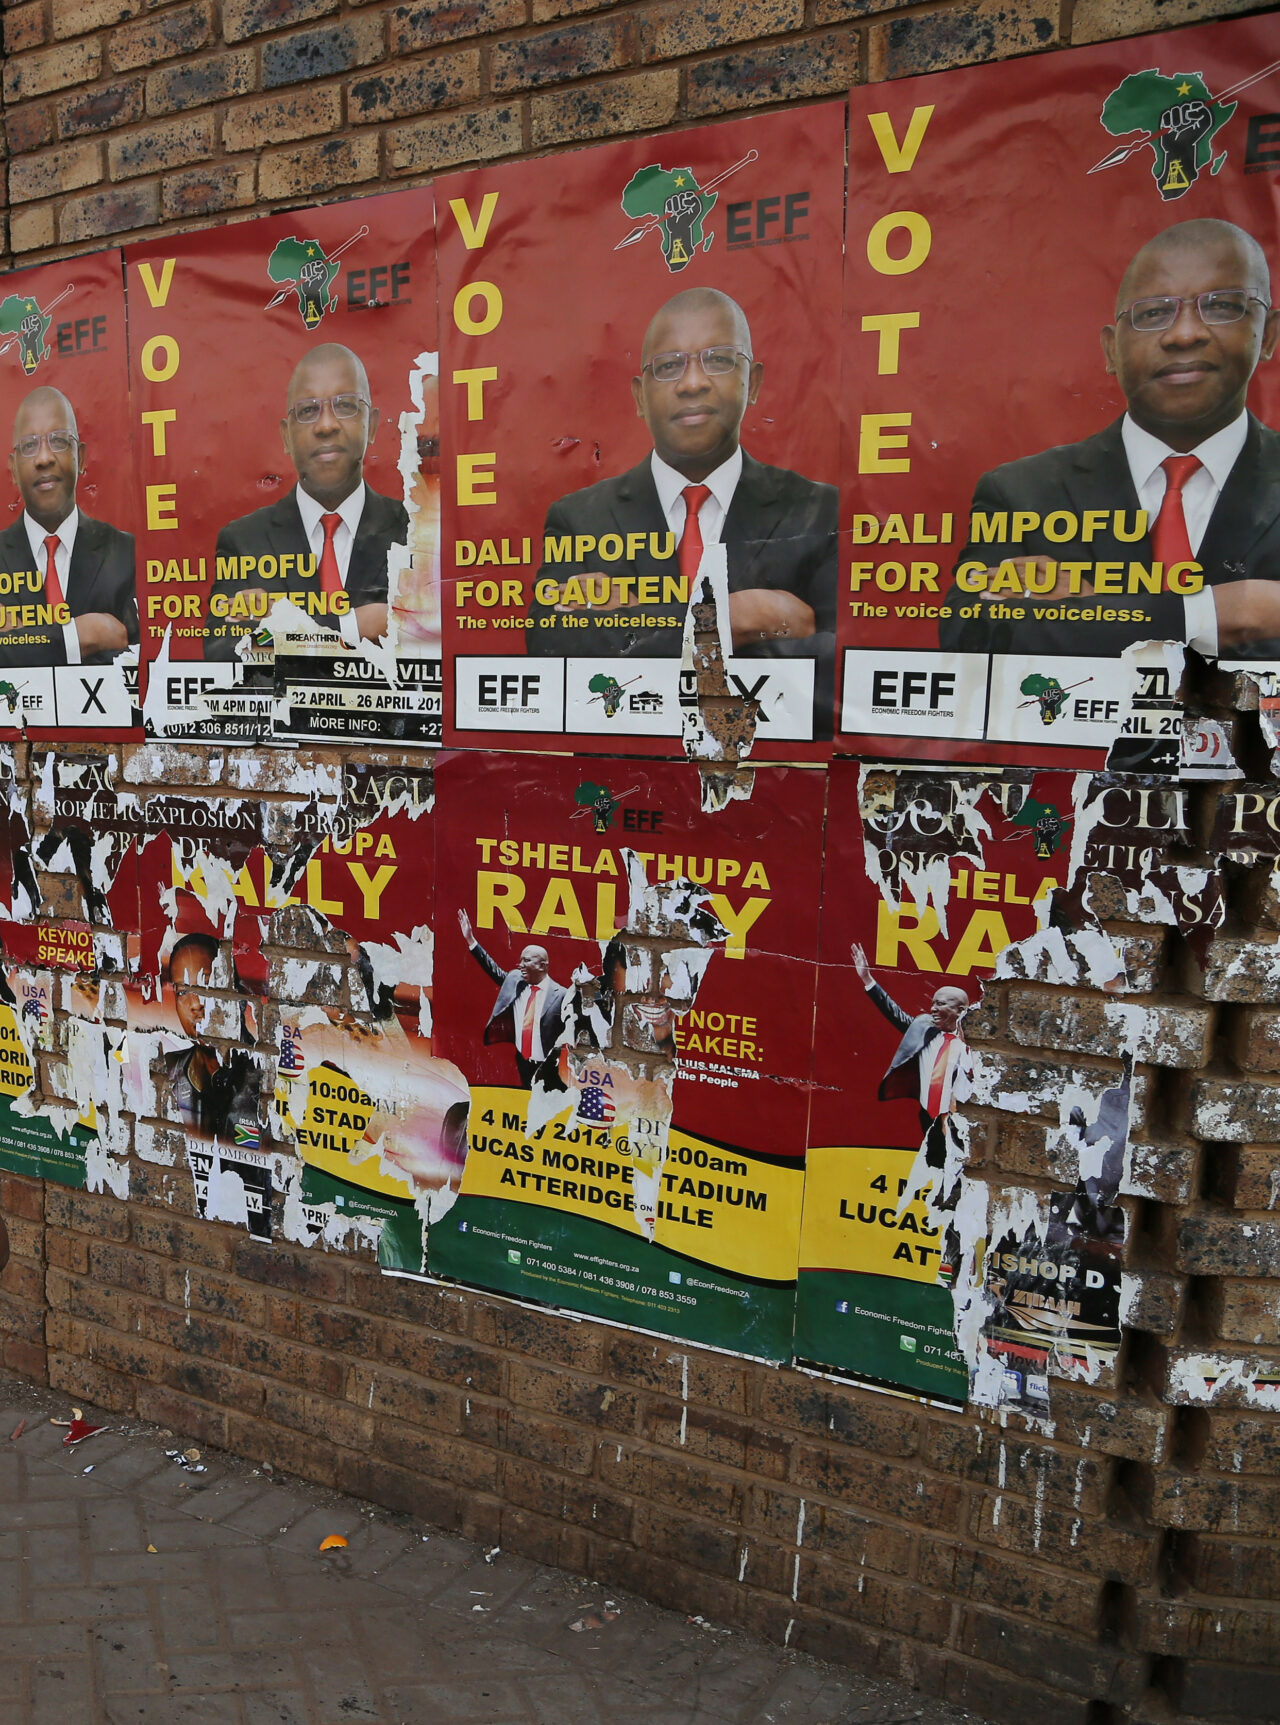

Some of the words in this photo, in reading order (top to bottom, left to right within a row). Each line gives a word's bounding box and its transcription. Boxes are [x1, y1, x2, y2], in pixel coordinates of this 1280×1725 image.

[727, 191, 810, 244] EFF
[346, 262, 411, 306] EFF
[857, 104, 935, 474] VOTE
[57, 315, 108, 354] EFF
[449, 191, 503, 507] VOTE
[137, 257, 180, 531] VOTE
[852, 512, 954, 545] DALI
[970, 509, 1149, 545] MPOFU
[455, 537, 532, 567] DALI
[544, 531, 676, 563] MPOFU
[146, 557, 207, 583] DALI
[216, 553, 317, 581] MPOFU
[849, 560, 940, 593] FOR
[955, 560, 1205, 596] GAUTENG
[147, 593, 202, 619] FOR
[456, 579, 525, 608] FOR
[535, 575, 689, 606] GAUTEN
[456, 615, 487, 629] The
[491, 615, 535, 629] voice
[539, 614, 557, 628] of
[561, 614, 589, 628] the
[594, 613, 683, 628] voiceless.
[849, 601, 888, 618] The
[894, 602, 953, 619] voice
[959, 603, 983, 619] of
[989, 604, 1026, 620] the
[1033, 605, 1152, 622] voiceless.
[176, 626, 210, 638] voice
[214, 625, 227, 637] of
[231, 625, 252, 637] the
[286, 633, 339, 643] BREAKTHRU
[22, 695, 43, 708] EFF
[310, 692, 346, 707] APRIL
[357, 694, 372, 708] 26
[375, 695, 414, 710] APRIL
[478, 675, 541, 706] EFF
[872, 670, 956, 709] EFF
[223, 700, 246, 712] 4PM
[872, 707, 900, 716] ECONOMIC
[901, 708, 927, 717] FREEDOM
[927, 709, 954, 718] FIGHTERS
[1073, 699, 1119, 719] EFF
[200, 723, 221, 735] 306
[224, 723, 271, 736] 8511/12
[309, 716, 345, 730] MORE
[348, 718, 381, 732] INFO:
[144, 802, 257, 831] EXPLOSION
[623, 809, 664, 830] EFF
[476, 837, 619, 876] TSHELA
[639, 852, 771, 890] THUPA
[477, 870, 772, 960] RALY
[579, 1069, 614, 1088] USA
[677, 1070, 696, 1081] the
[698, 1073, 739, 1088] People
[481, 1110, 494, 1125] 4
[553, 1122, 609, 1149] 2014
[542, 1148, 634, 1182] MORIPE
[661, 1172, 768, 1212] TADIUM
[500, 1168, 714, 1229] ATTERIDGEILLE
[839, 1199, 939, 1237] LUCAS
[472, 1226, 501, 1240] Economic
[501, 1233, 527, 1246] Freedom
[528, 1239, 553, 1252] Fighters
[573, 1251, 640, 1273] www.effighters.org.za
[992, 1251, 1076, 1283] ISHOP
[526, 1257, 540, 1267] 071
[541, 1261, 556, 1271] 400
[558, 1265, 577, 1276] 5384
[583, 1271, 597, 1281] 081
[599, 1276, 614, 1286] 436
[615, 1280, 635, 1292] 3908
[641, 1286, 657, 1297] 078
[659, 1290, 674, 1300] 853
[676, 1295, 697, 1306] 3559
[854, 1306, 891, 1322] Economic
[892, 1315, 926, 1331] Freedom
